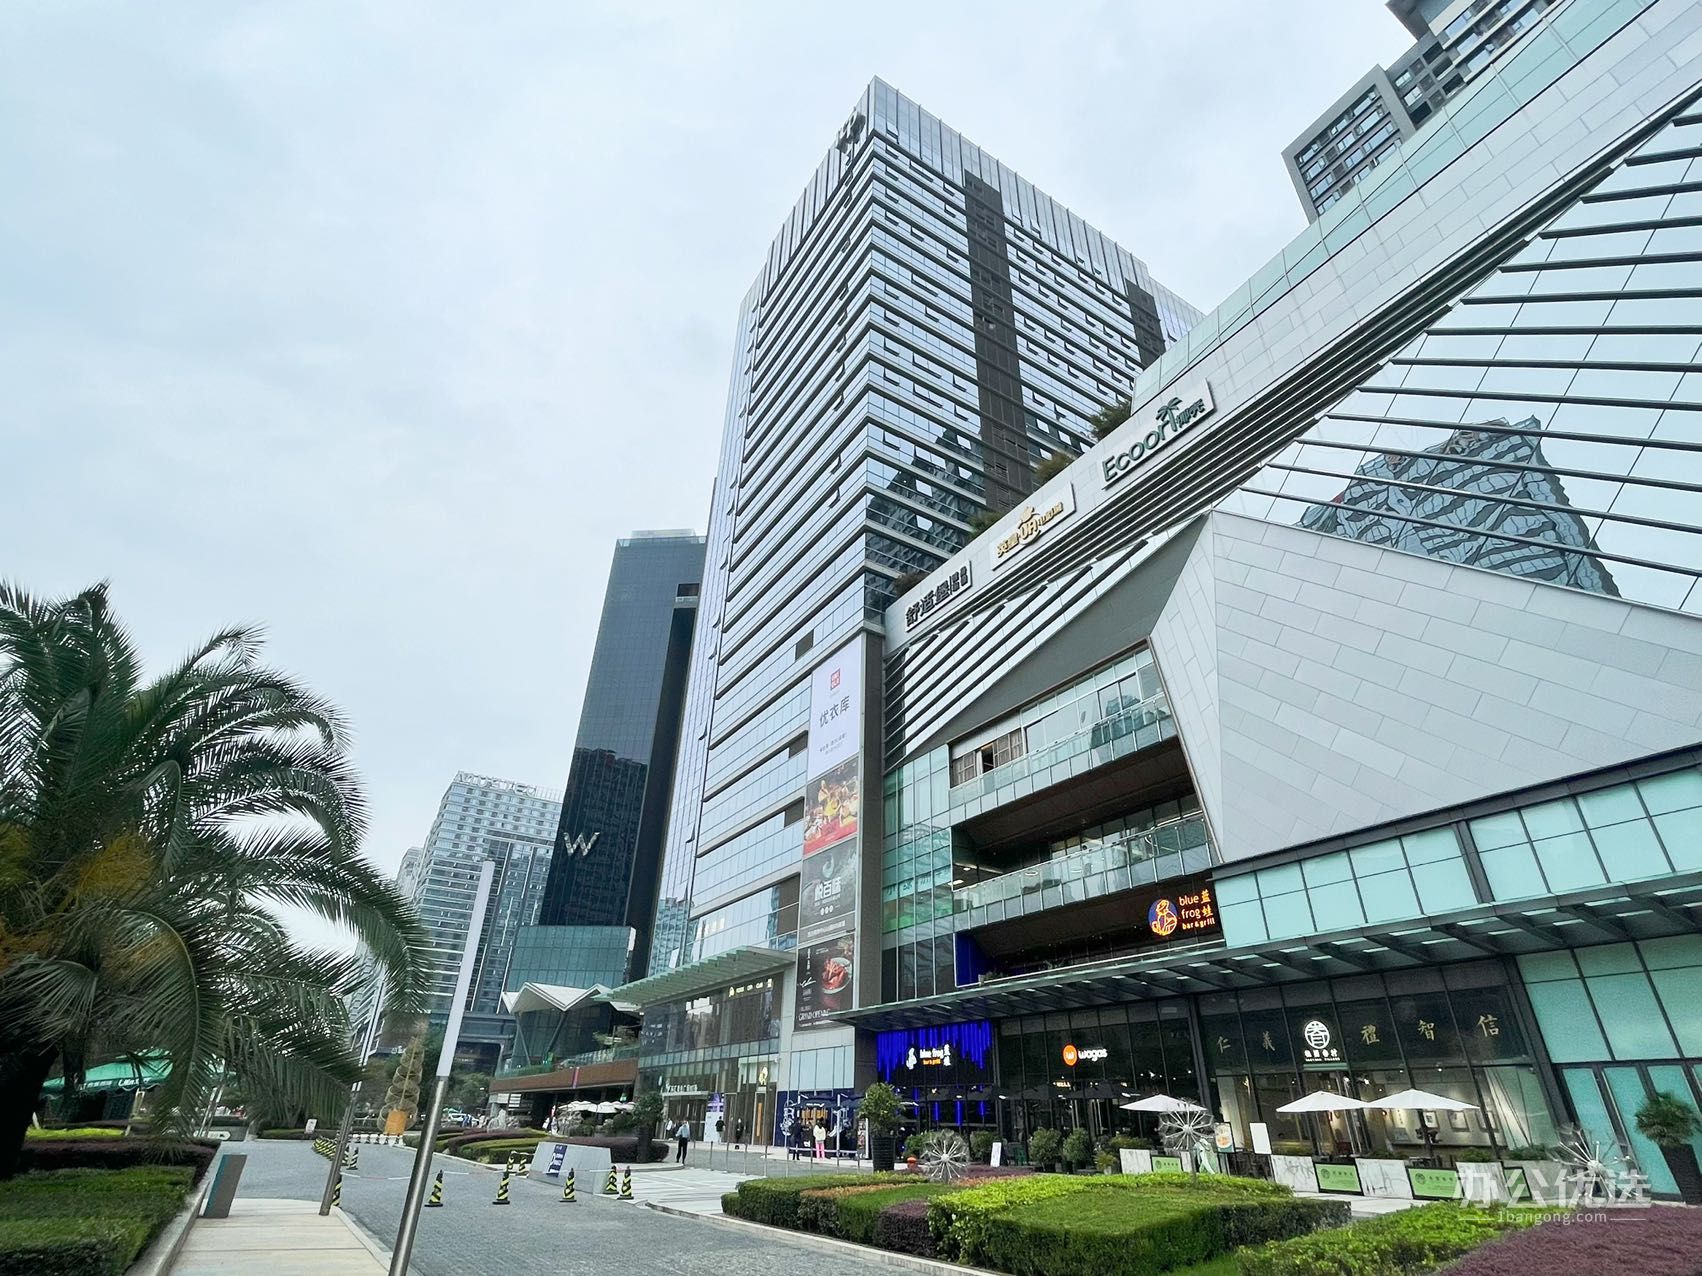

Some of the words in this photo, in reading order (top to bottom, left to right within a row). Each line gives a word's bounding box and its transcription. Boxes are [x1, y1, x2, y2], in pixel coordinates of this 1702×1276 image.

[820, 695, 850, 728] 优衣库
[562, 832, 600, 857] W
[1179, 895, 1199, 906] blue
[1181, 908, 1201, 919] frog
[1182, 922, 1194, 930] bar
[1200, 917, 1216, 928] grill
[1216, 1035, 1231, 1055] 仁
[1418, 1019, 1435, 1041] 智
[1477, 1014, 1499, 1037] 信
[1077, 1048, 1108, 1062] wagas
